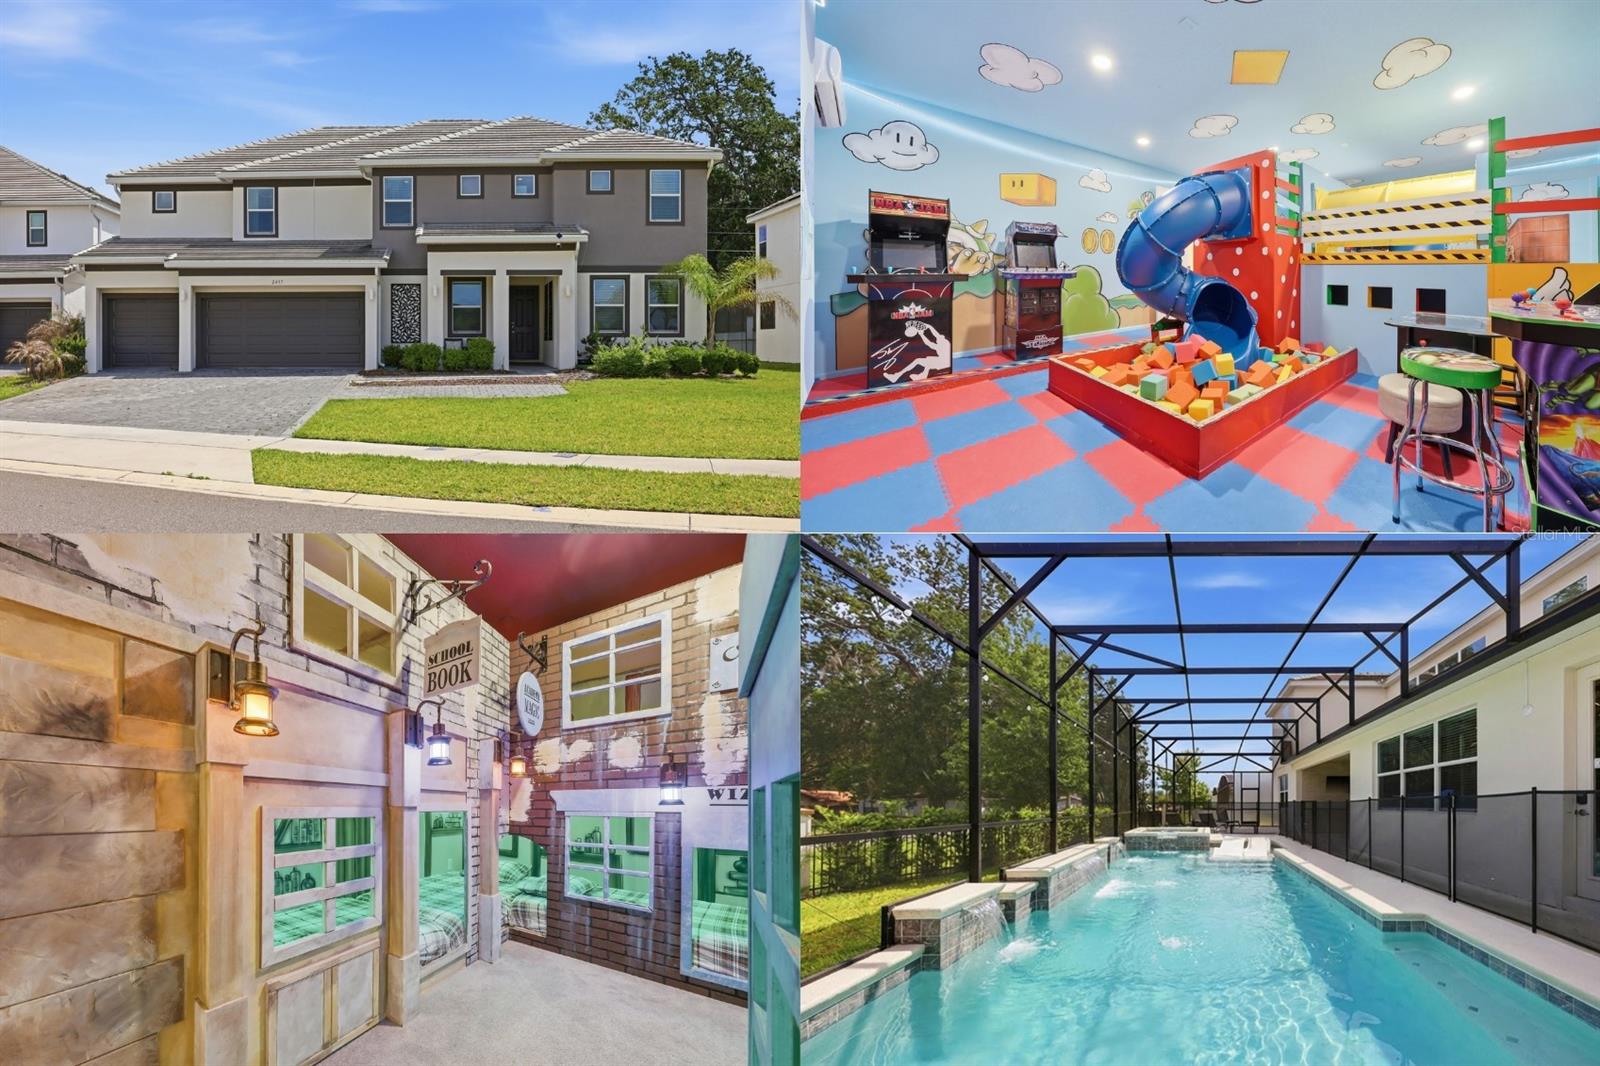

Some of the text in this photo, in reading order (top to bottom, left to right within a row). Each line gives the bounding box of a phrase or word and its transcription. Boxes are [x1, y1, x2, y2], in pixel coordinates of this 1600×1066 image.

[874, 198, 946, 214] NBA JAM
[428, 640, 474, 667] SCHOOL
[427, 659, 472, 693] BOOK
[707, 787, 748, 800] WIZ
